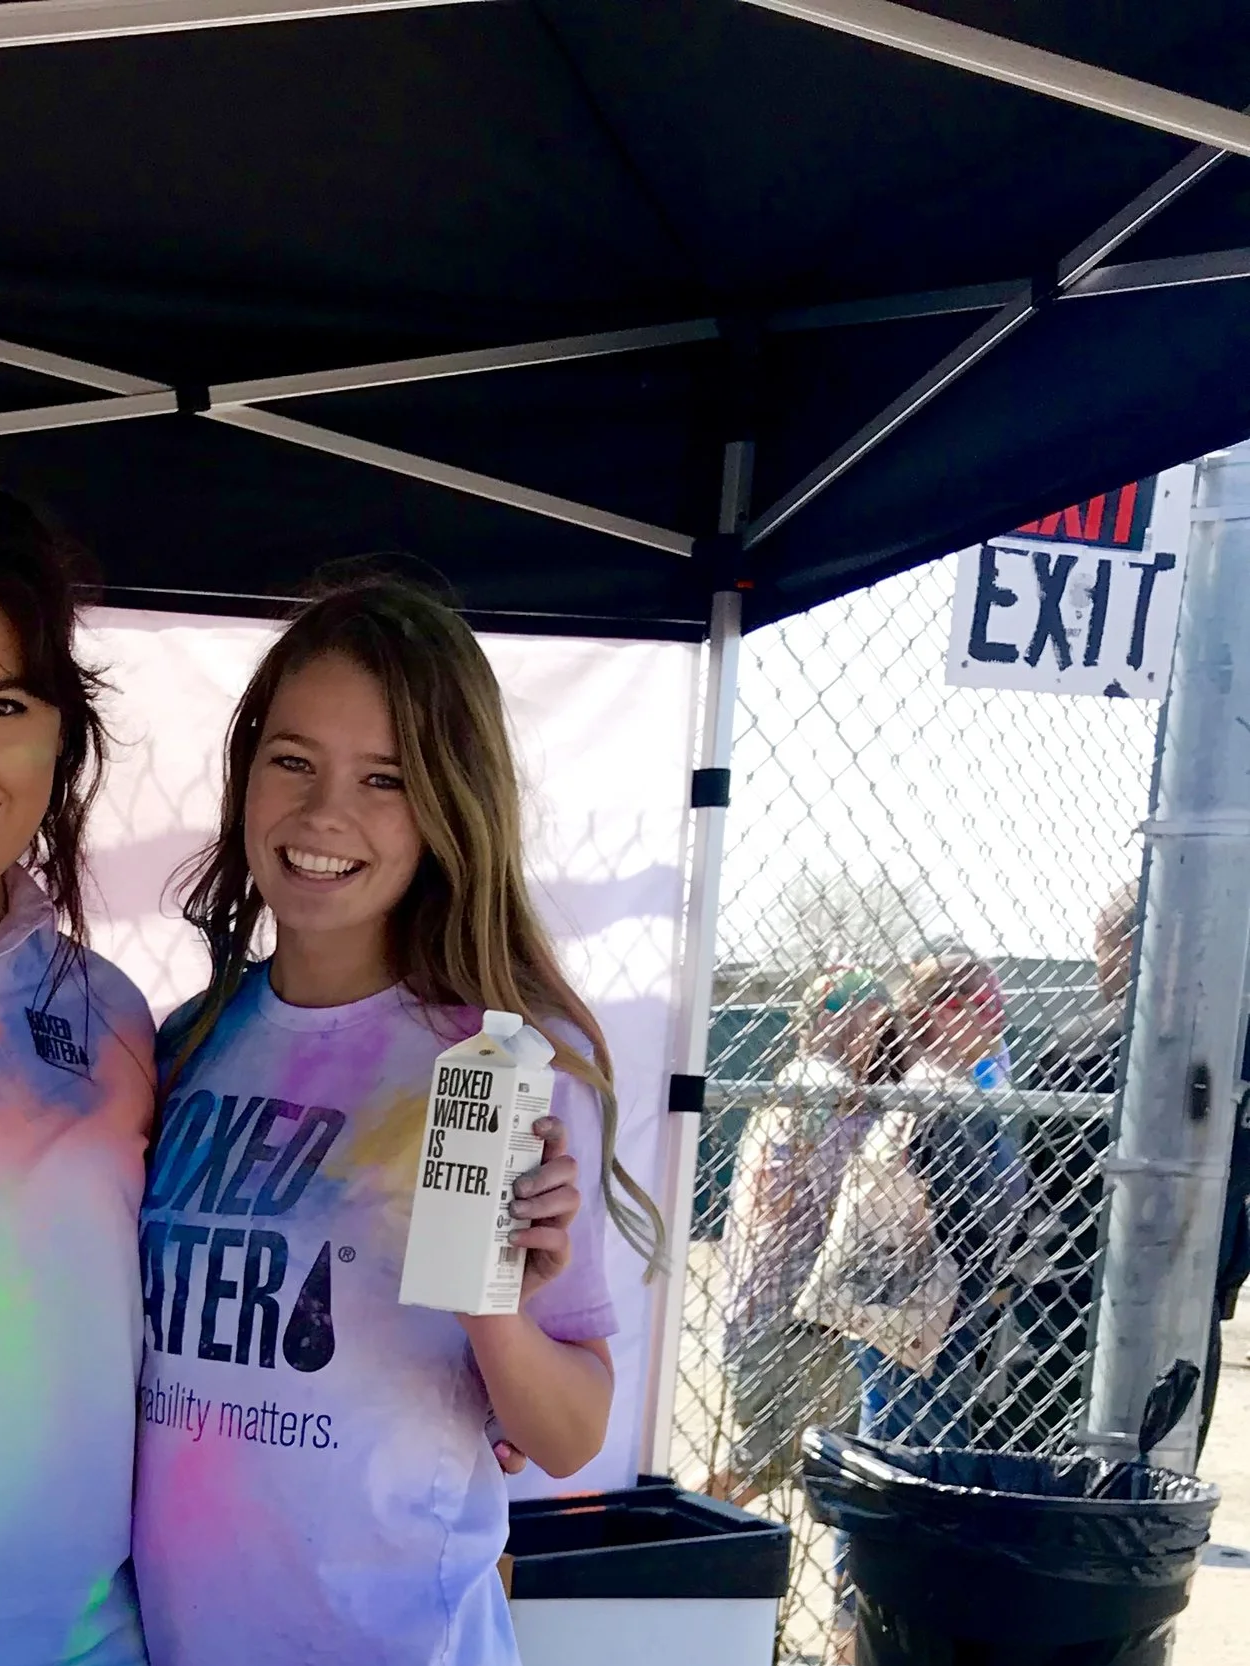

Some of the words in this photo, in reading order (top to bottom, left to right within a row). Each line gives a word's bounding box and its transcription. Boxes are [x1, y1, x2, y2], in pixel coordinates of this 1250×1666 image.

[968, 544, 1177, 671] EXIT
[436, 1066, 494, 1101] BOXED
[433, 1097, 490, 1132] WATER
[142, 1088, 346, 1217] OXED
[427, 1128, 446, 1159] IS
[422, 1159, 492, 1197] BETTER.
[139, 1220, 288, 1369] ATER
[218, 1400, 339, 1449] matters.
